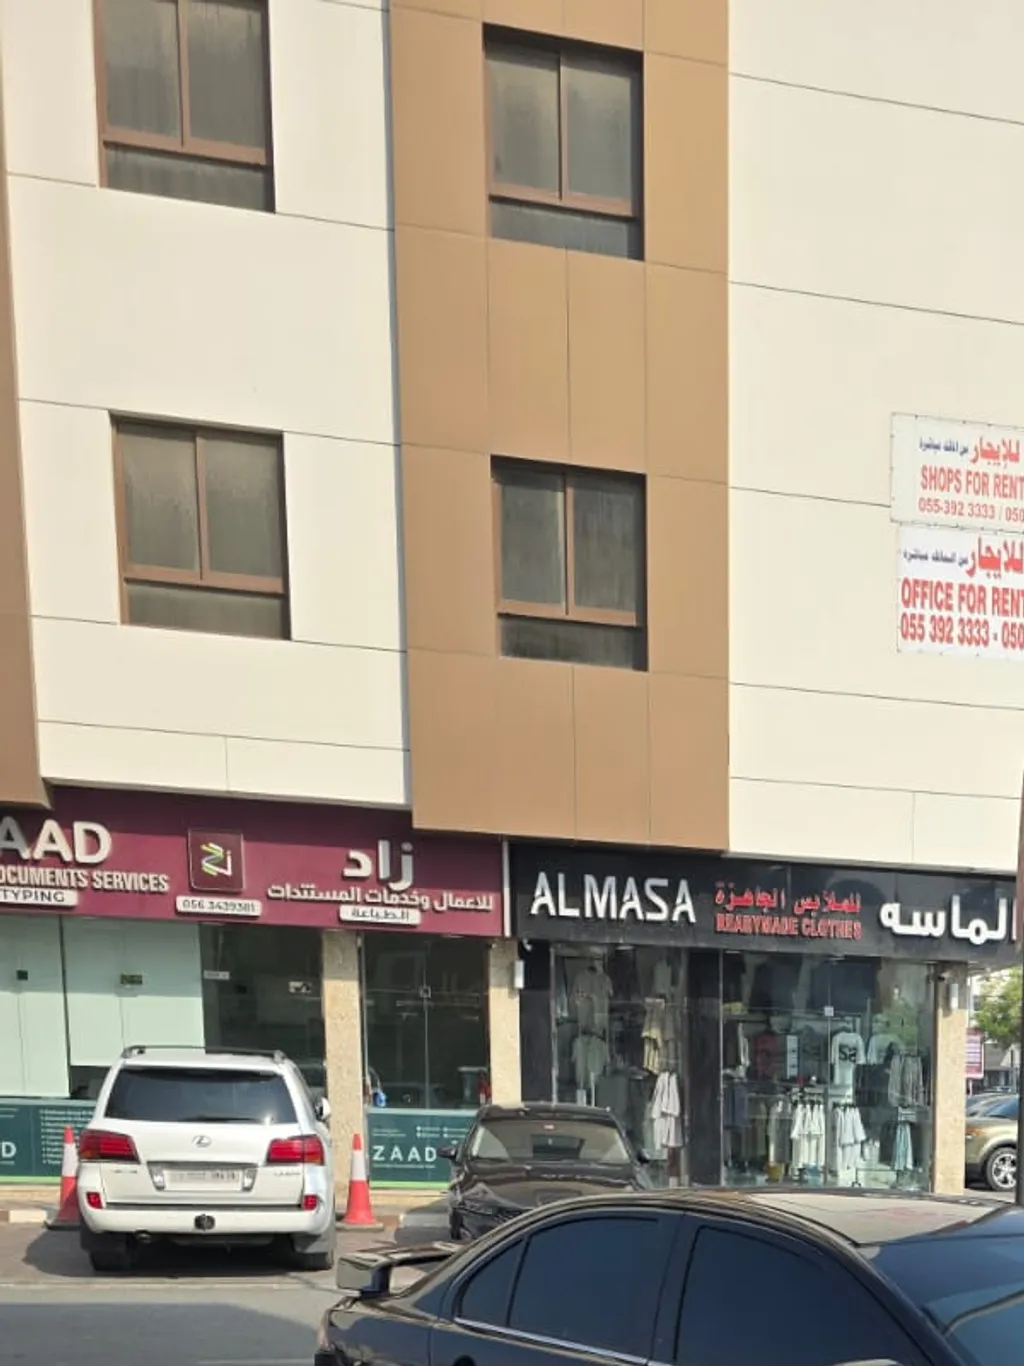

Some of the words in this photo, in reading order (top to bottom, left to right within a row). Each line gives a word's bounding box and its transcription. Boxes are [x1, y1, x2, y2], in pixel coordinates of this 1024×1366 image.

[921, 465, 962, 494] SHOPS
[966, 470, 989, 496] FOR
[968, 502, 996, 520] 3333
[901, 577, 953, 612] OFFICE
[958, 584, 986, 615] FOR
[901, 613, 925, 642] 055
[929, 615, 953, 644] 392
[958, 618, 990, 647] 3333
[1002, 622, 1024, 649] 050
[342, 839, 413, 891] زاد
[93, 872, 170, 893] SERVICES
[267, 882, 361, 902] المستندات
[3, 888, 65, 903] TYPING
[365, 887, 430, 911] وخدمات
[530, 871, 697, 923] ALMASA
[801, 917, 862, 940] CLOTHES
[372, 1145, 437, 1162] ZAAD
